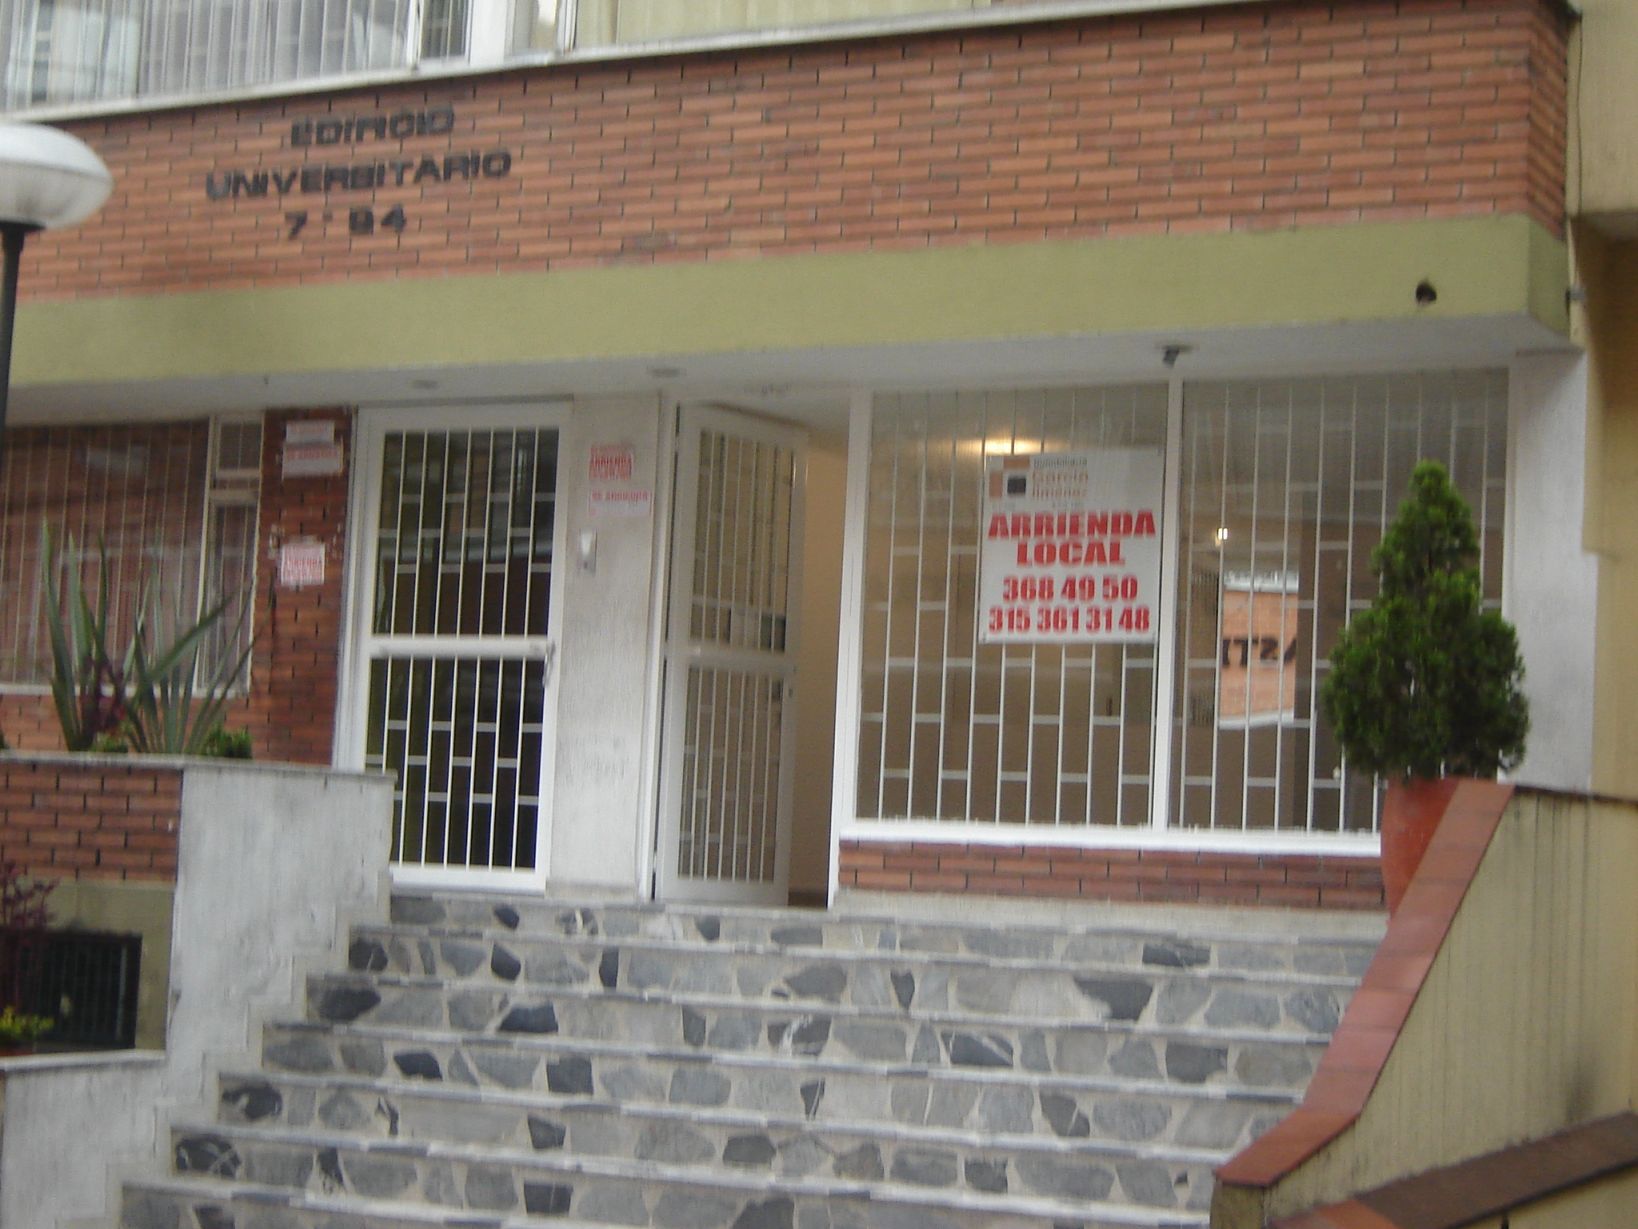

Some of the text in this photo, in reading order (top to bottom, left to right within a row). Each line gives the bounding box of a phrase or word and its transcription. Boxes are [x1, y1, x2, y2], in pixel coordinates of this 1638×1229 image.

[988, 509, 1156, 540] ARRIENDA
[1016, 541, 1126, 568] LOCAL
[1003, 574, 1139, 602] 368 49 50
[988, 606, 1151, 633] 315 361 31 48
